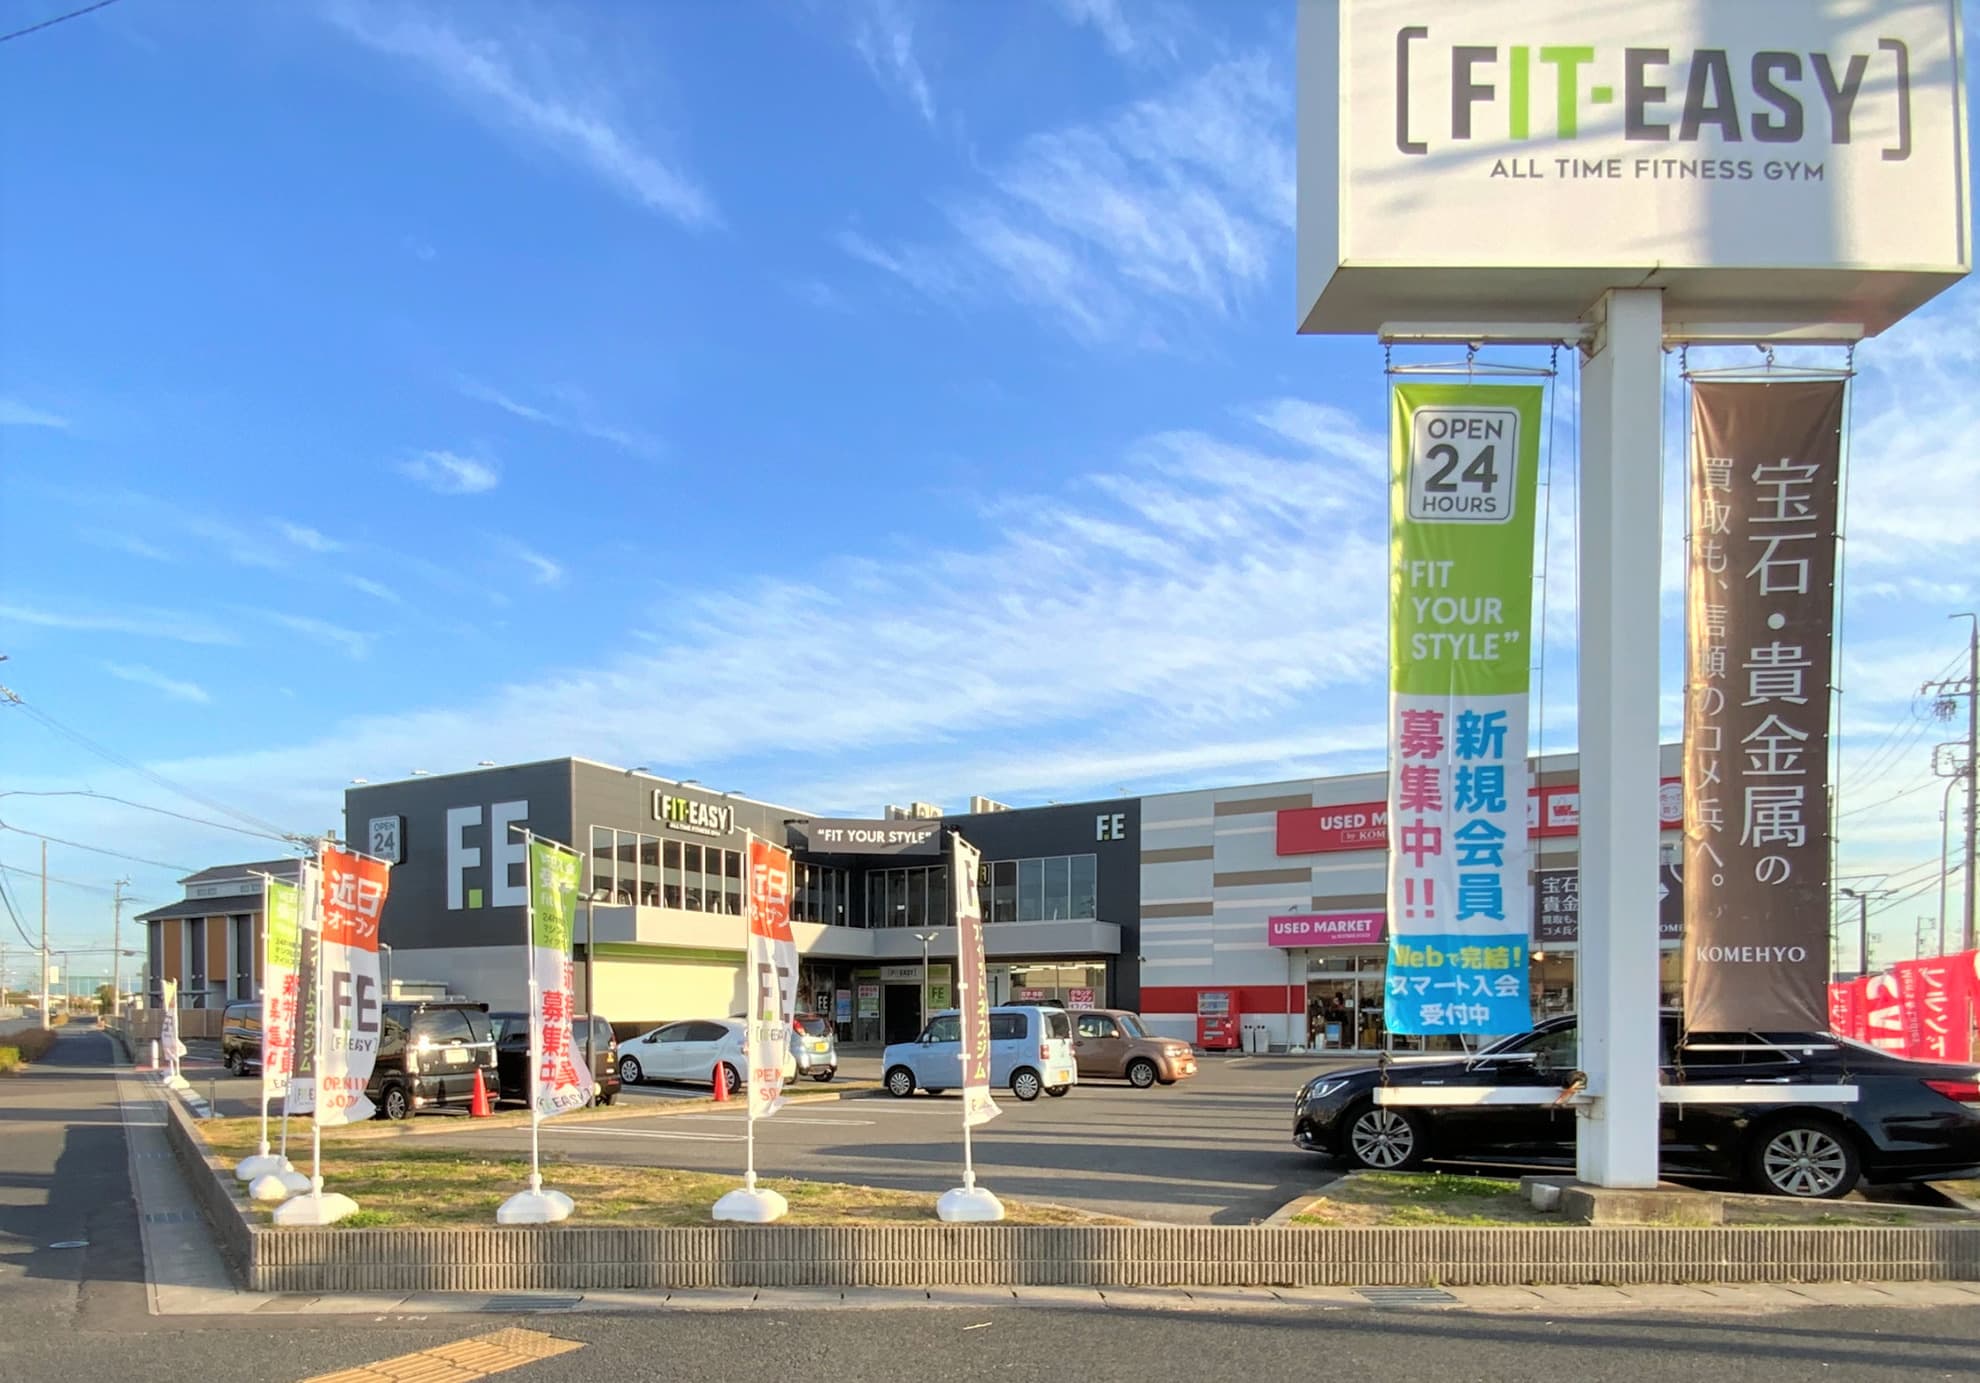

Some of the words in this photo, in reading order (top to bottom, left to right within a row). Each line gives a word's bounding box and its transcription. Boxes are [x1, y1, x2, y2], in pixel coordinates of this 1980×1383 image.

[1490, 158, 1544, 179] ALL
[1554, 158, 1622, 179] TIME
[1634, 158, 1754, 180] FITNESS
[1763, 160, 1825, 181] GYM
[1427, 418, 1503, 440] OPEN
[1424, 444, 1498, 493] 24
[1422, 495, 1497, 513] HOURS
[1411, 597, 1504, 625] YOUR
[1739, 457, 1820, 886] 宝石・貴金属の
[1320, 815, 1366, 831] USED
[1453, 709, 1507, 922] 新規会員
[373, 832, 396, 852] 24
[847, 829, 885, 843] YOUR
[329, 869, 383, 917] 近日
[1274, 923, 1310, 934] USED
[1314, 920, 1373, 933] MARKET
[1697, 946, 1806, 962] KOMEHYO
[1391, 974, 1521, 998] スマート入会
[1420, 1003, 1490, 1026] 受付中
